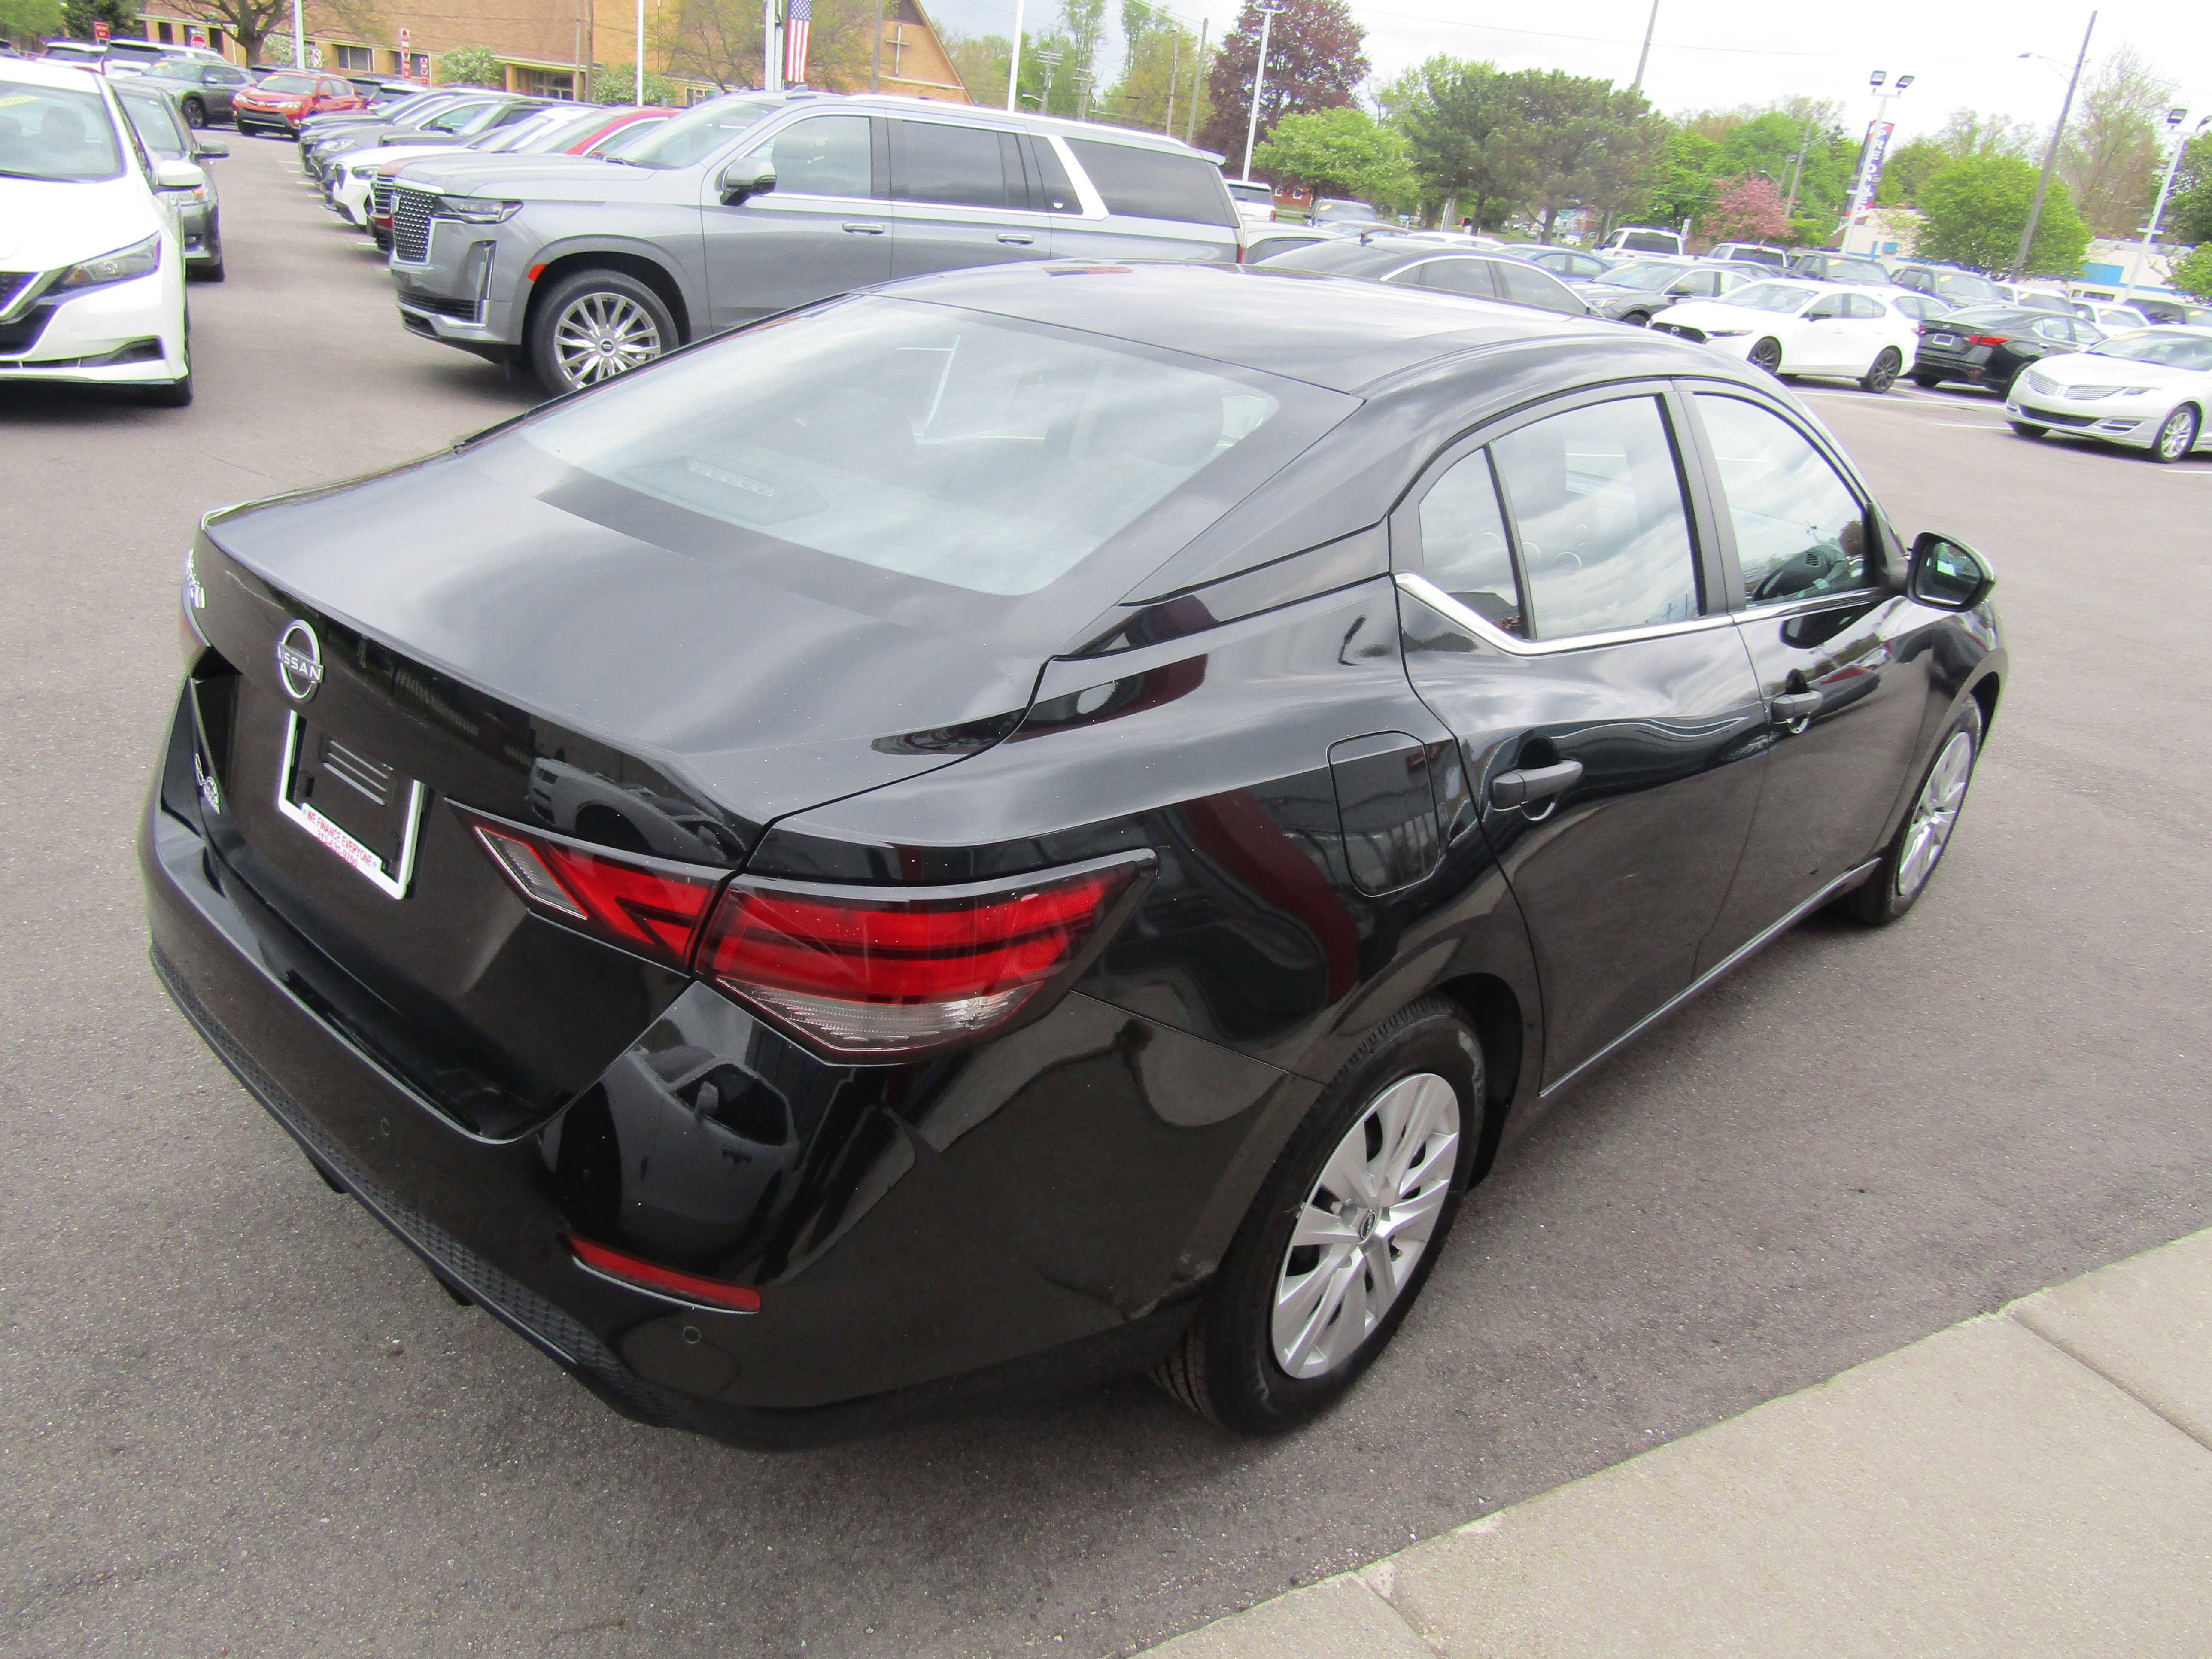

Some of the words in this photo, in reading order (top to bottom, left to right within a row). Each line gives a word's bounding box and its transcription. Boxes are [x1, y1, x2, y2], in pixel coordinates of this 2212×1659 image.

[277, 645, 321, 681] NISSAN
[307, 809, 316, 824] WE
[317, 817, 342, 842] FINANCE
[342, 836, 373, 867] EVERYONE
